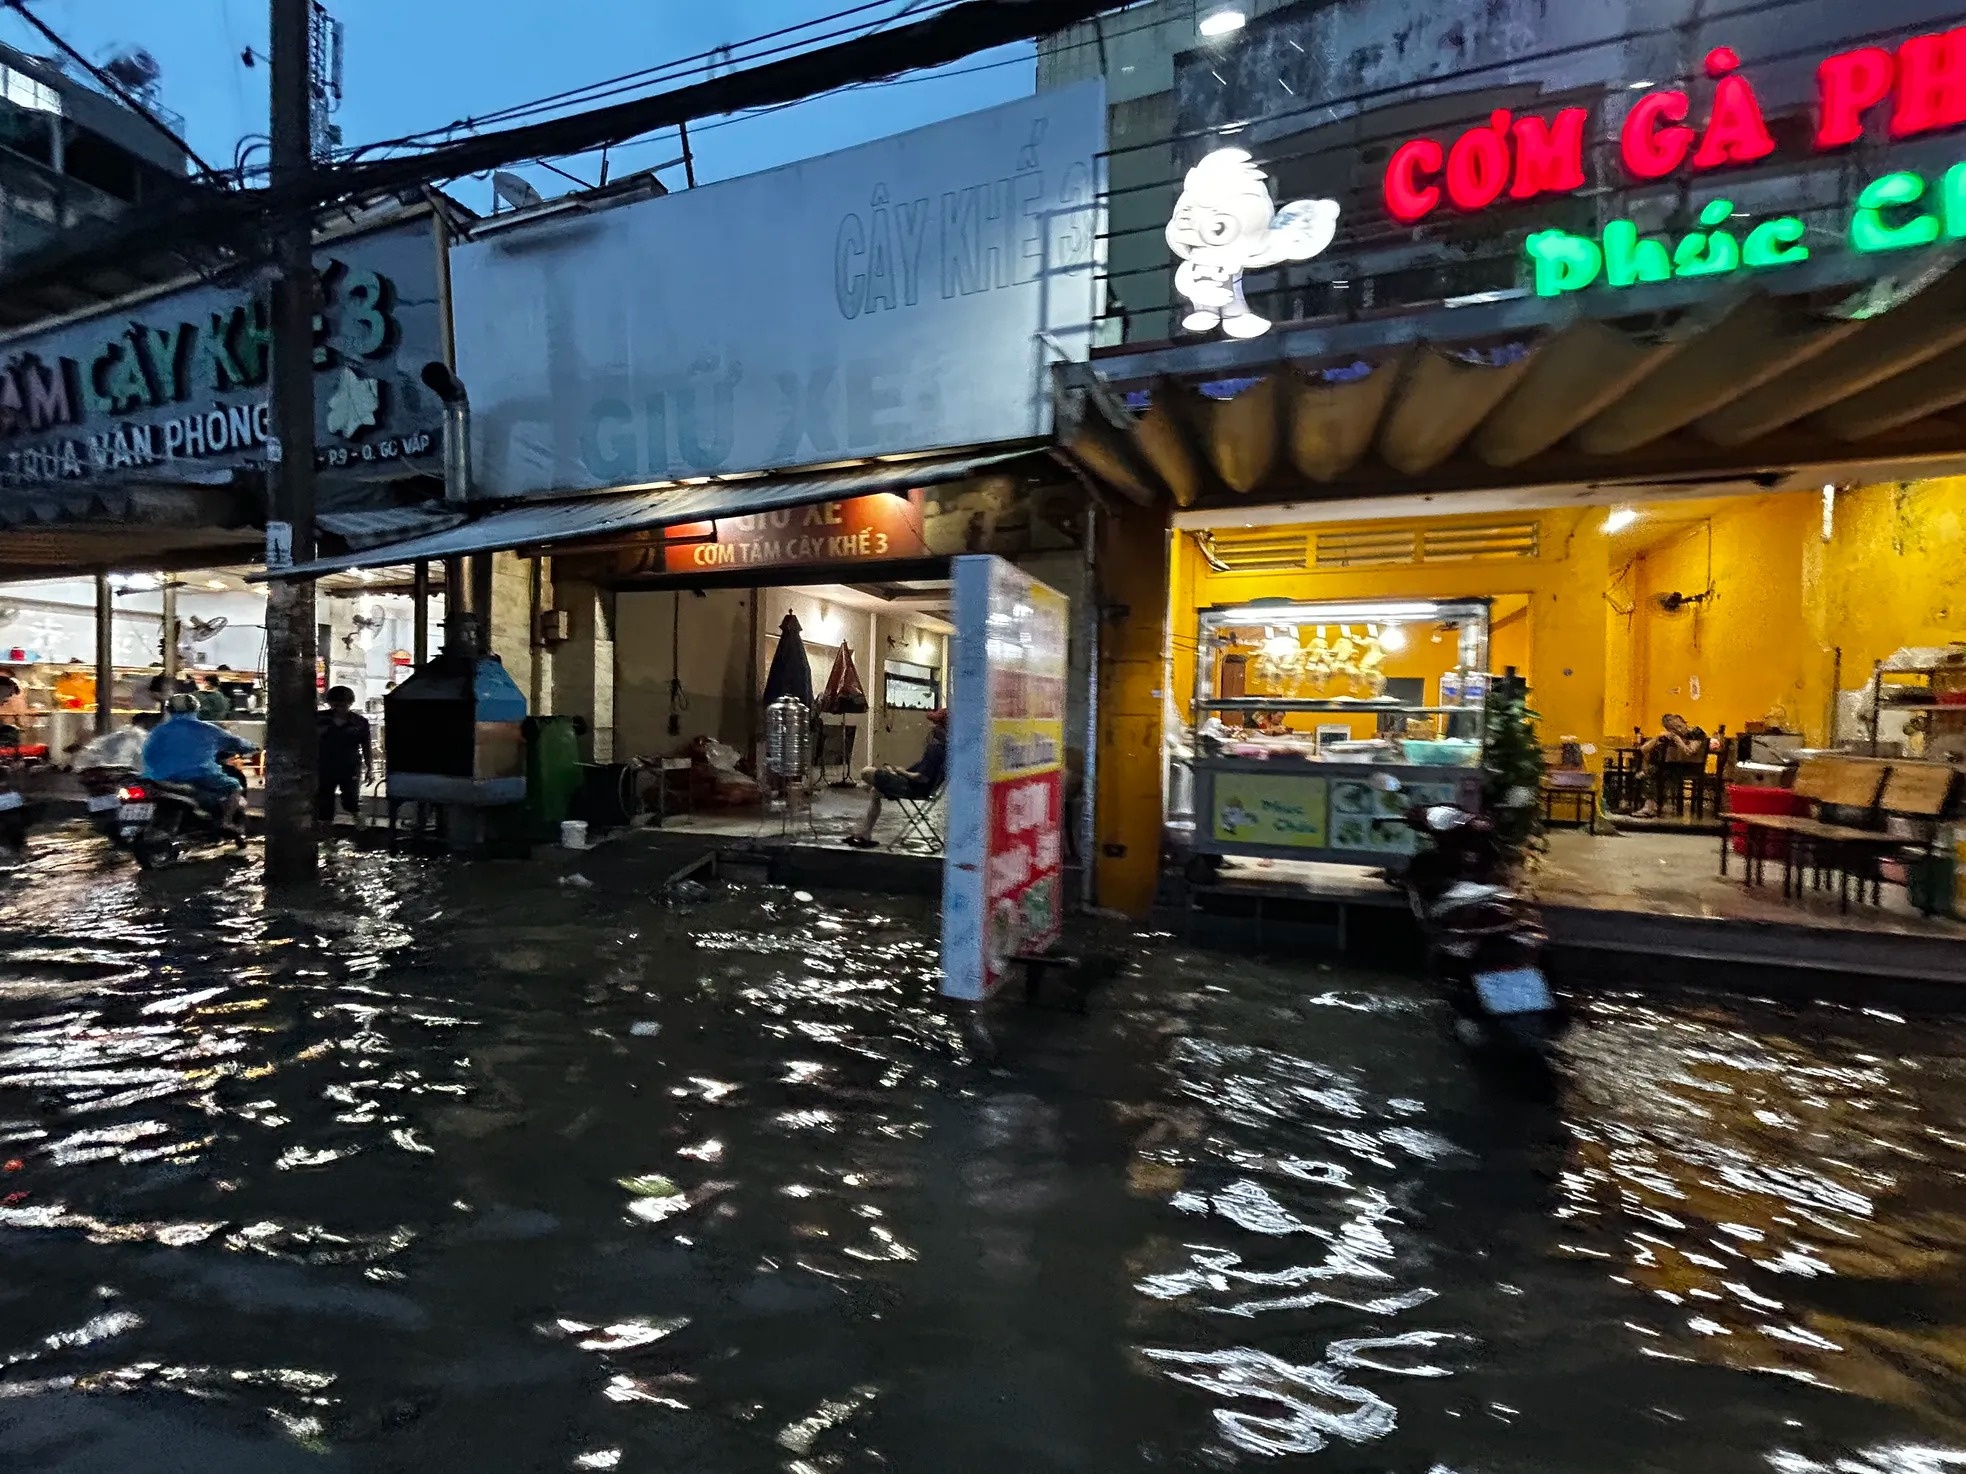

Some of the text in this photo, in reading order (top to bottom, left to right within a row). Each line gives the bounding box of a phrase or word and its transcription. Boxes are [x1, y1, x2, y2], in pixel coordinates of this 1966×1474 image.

[1384, 107, 1587, 226] CƠM
[834, 181, 929, 320] CÂY
[334, 268, 386, 356] 3
[693, 526, 889, 566] CƠM TẤM CÂY KHẾ 3
